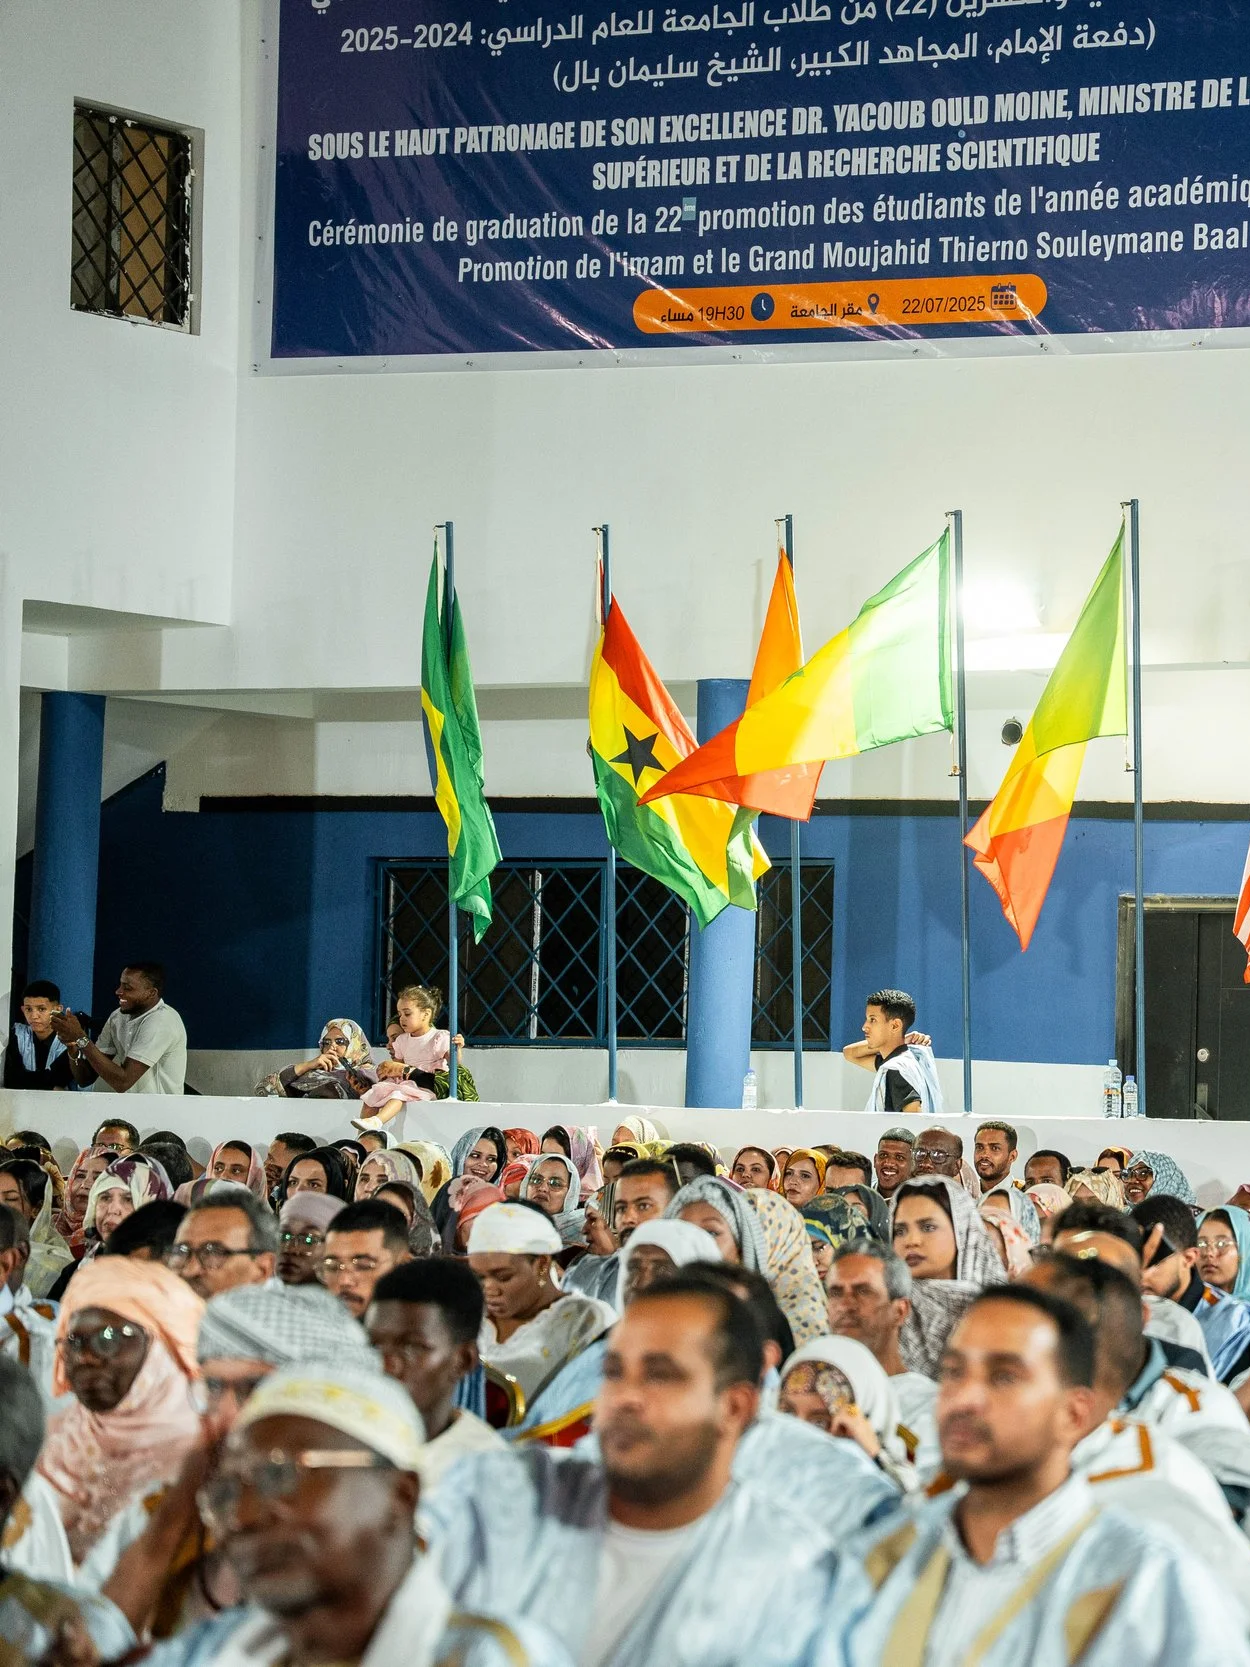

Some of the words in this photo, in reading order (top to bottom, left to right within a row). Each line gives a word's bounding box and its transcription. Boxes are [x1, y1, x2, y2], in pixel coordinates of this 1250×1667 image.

[592, 9, 654, 45] للعام
[662, 1, 755, 36] الجامعة
[763, 0, 831, 33] طلاب
[840, 0, 877, 25] من
[480, 14, 583, 57] الدراسي:
[878, 31, 978, 69] المجاهد
[987, 25, 1063, 64] الإمام،
[608, 54, 699, 88] سليمان
[706, 42, 781, 87] الشيخ
[790, 40, 869, 78] الكبير،
[308, 131, 364, 161] SOUS
[368, 130, 390, 158] LE
[394, 127, 450, 157] HAUT
[453, 121, 575, 154] PATRONAGE
[580, 119, 607, 148] DE
[610, 116, 655, 147] SON
[659, 108, 787, 144] EXCELLENCE
[791, 106, 828, 136] DR.
[833, 100, 926, 133] YACOUB
[931, 95, 989, 128] OULD
[994, 88, 1073, 123] MOINE,
[1078, 80, 1197, 117] MINISTRE
[1201, 77, 1233, 109] DE
[592, 155, 711, 191] SUPÉRIEUR
[715, 154, 741, 184] ET
[744, 152, 772, 182] DE
[776, 151, 803, 181] LA
[807, 143, 942, 179] RECHERCHE
[946, 132, 1101, 172] SCIENTIFIQUE
[308, 217, 424, 247] Cérémonie
[432, 215, 458, 242] de
[465, 211, 584, 247] graduation
[591, 209, 619, 236] de
[627, 207, 647, 234] la
[698, 199, 815, 237] promotion
[823, 197, 865, 225] des
[873, 191, 986, 222] étudiants
[994, 188, 1022, 217] de
[1030, 181, 1119, 214] l'année
[458, 255, 568, 283] Promotion
[575, 253, 601, 279] de
[609, 251, 685, 279] l'imam
[693, 249, 714, 275] et
[721, 247, 741, 273] le
[748, 243, 815, 272] Grand
[823, 237, 931, 273] Moujahid
[938, 235, 1028, 263] Thierno
[1036, 229, 1184, 262] Souleymane
[1193, 220, 1249, 251] Baal
[660, 307, 695, 323] مساء
[697, 305, 745, 322] 19H30
[840, 302, 863, 320] مقر
[901, 295, 986, 314] 22/07/2025
